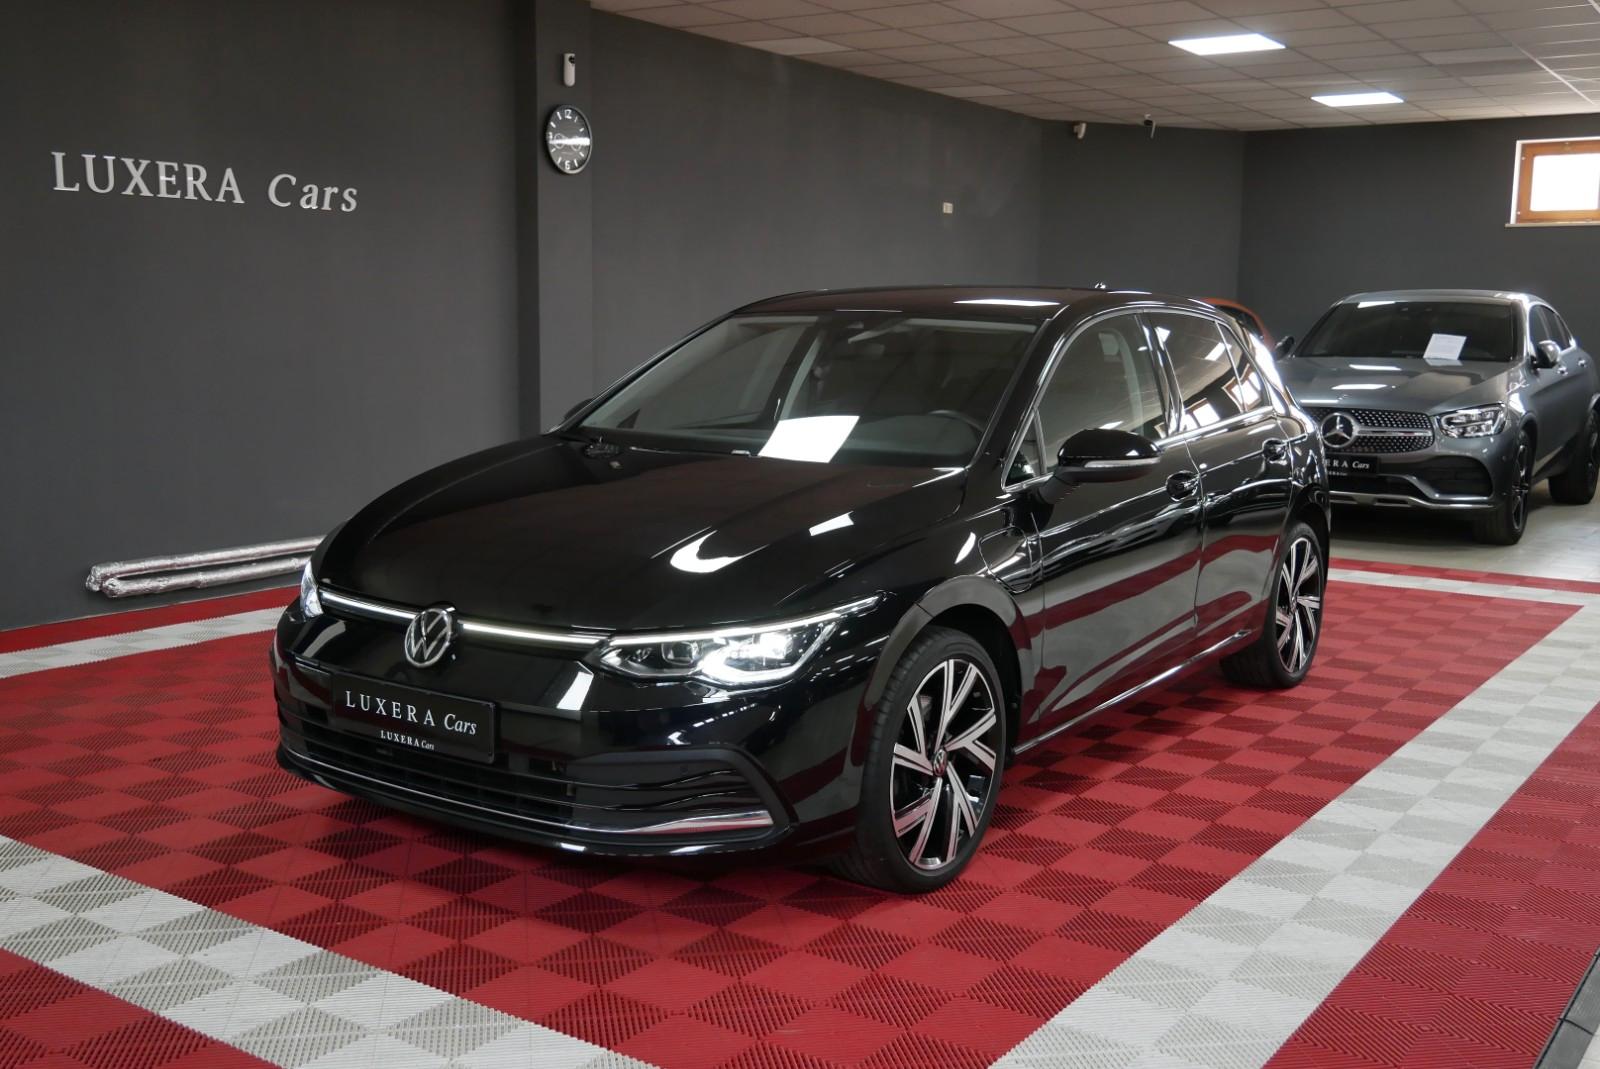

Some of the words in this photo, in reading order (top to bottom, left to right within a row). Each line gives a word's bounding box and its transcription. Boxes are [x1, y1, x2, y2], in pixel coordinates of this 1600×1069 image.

[51, 151, 246, 204] LUXERA
[267, 173, 358, 212] Cars
[1352, 461, 1370, 470] Cars
[345, 690, 436, 727] LUXERA
[443, 713, 477, 735] Cars
[380, 729, 420, 748] LUXERA
[421, 740, 435, 750] Cars
